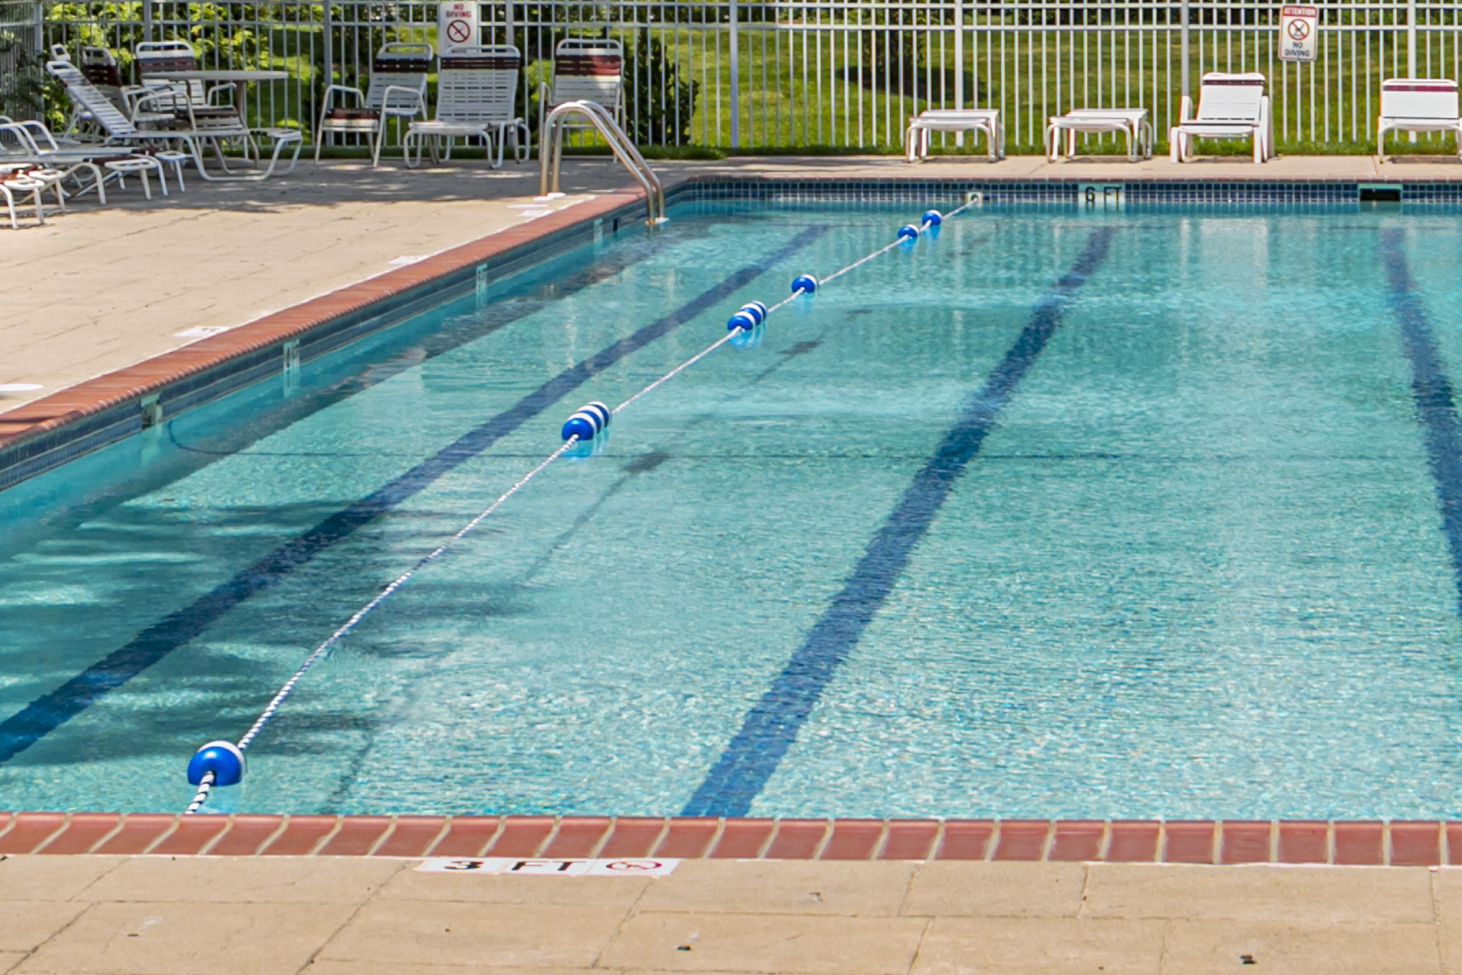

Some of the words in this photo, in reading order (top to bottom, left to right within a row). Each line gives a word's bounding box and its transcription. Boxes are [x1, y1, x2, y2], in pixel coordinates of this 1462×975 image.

[1085, 186, 1095, 201] 6
[1103, 186, 1122, 202] FT
[443, 860, 484, 871] 3
[511, 861, 586, 872] FT
